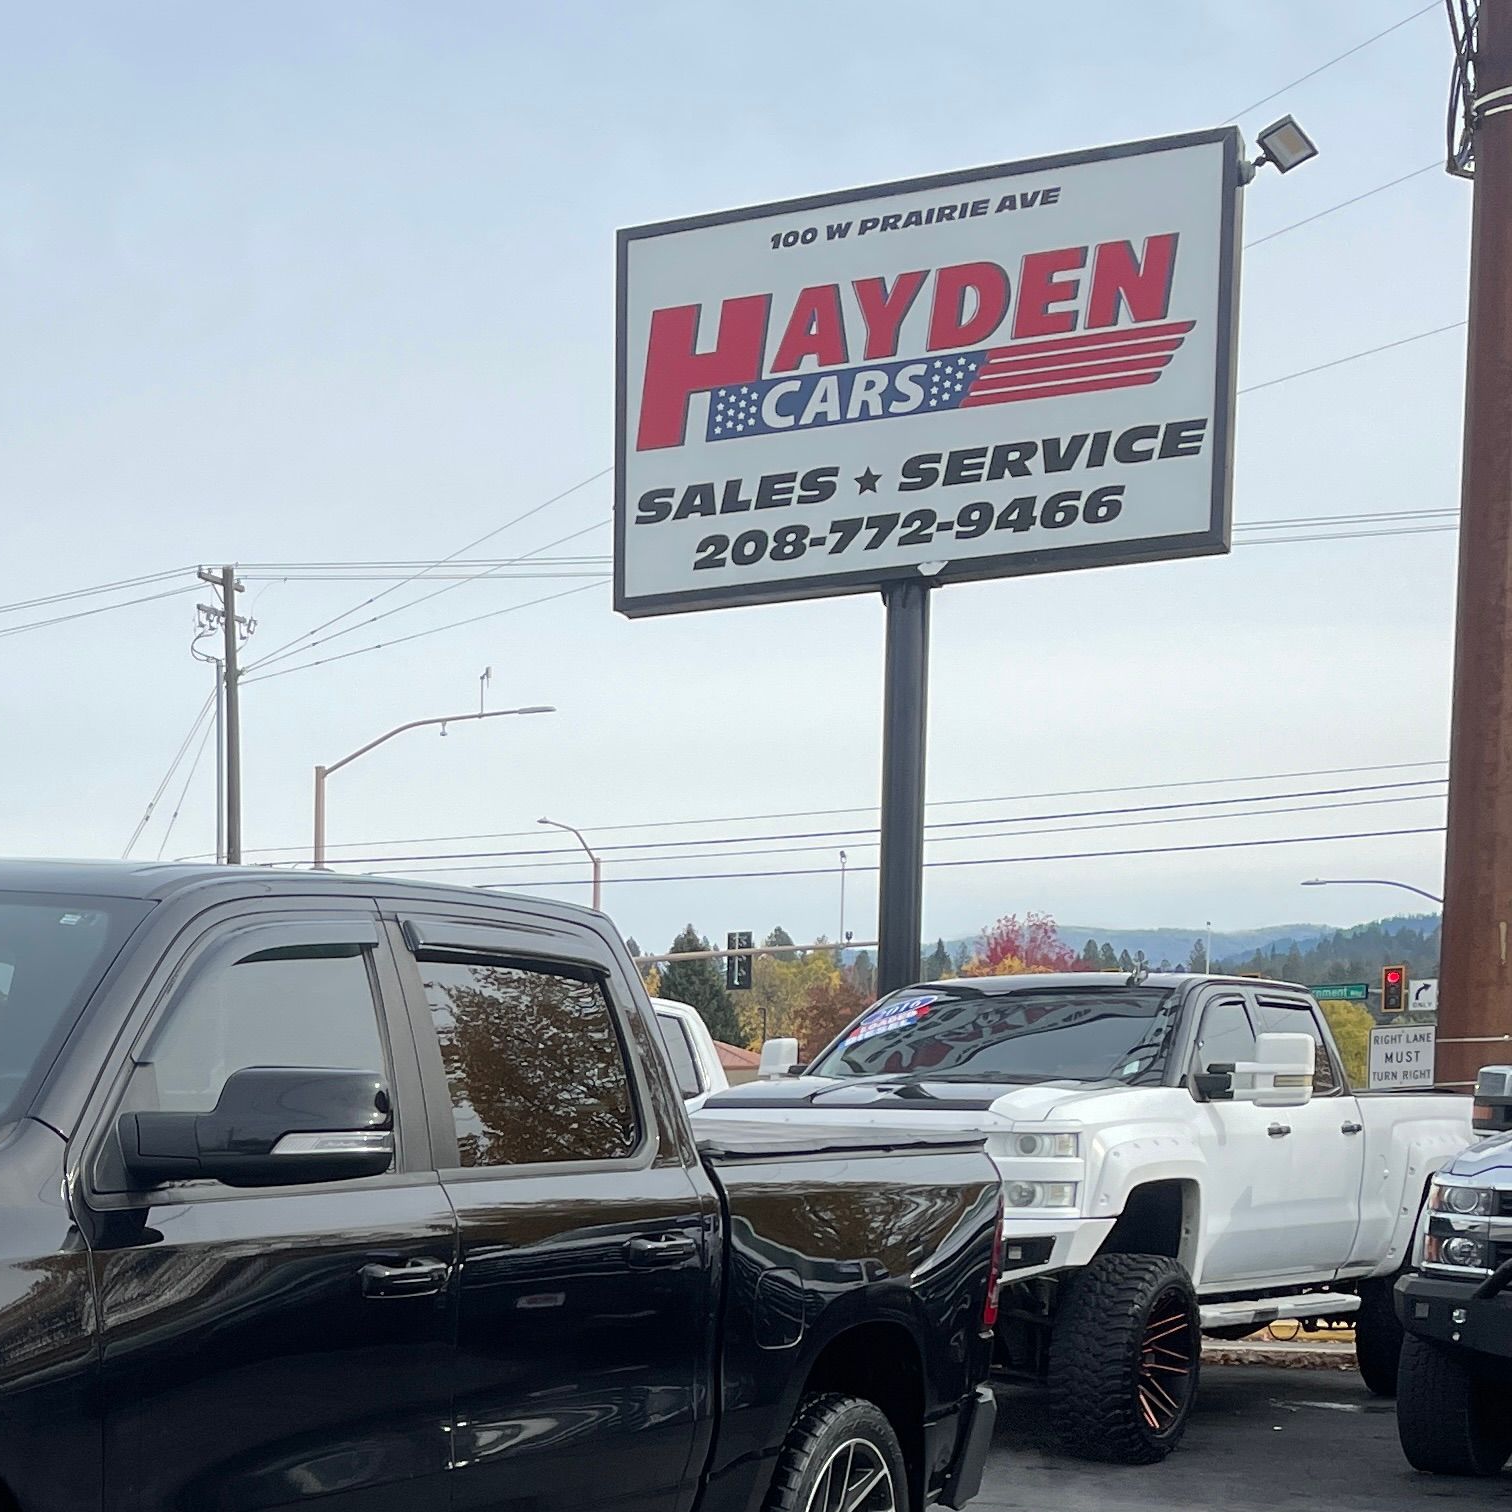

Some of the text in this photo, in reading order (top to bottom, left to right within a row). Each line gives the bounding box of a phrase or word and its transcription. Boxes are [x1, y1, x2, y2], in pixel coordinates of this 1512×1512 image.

[770, 186, 1062, 250] 100 W PRAIRIE AVE
[635, 232, 1180, 452] HAYDEN
[760, 362, 927, 430] CARS
[634, 418, 1208, 525] SALES SERVICE
[692, 484, 1127, 571] 208-772-9466
[1373, 1032, 1432, 1046] RIGHT LANE
[1384, 1050, 1420, 1064] MUST
[1372, 1069, 1431, 1082] TURN RIGHT
